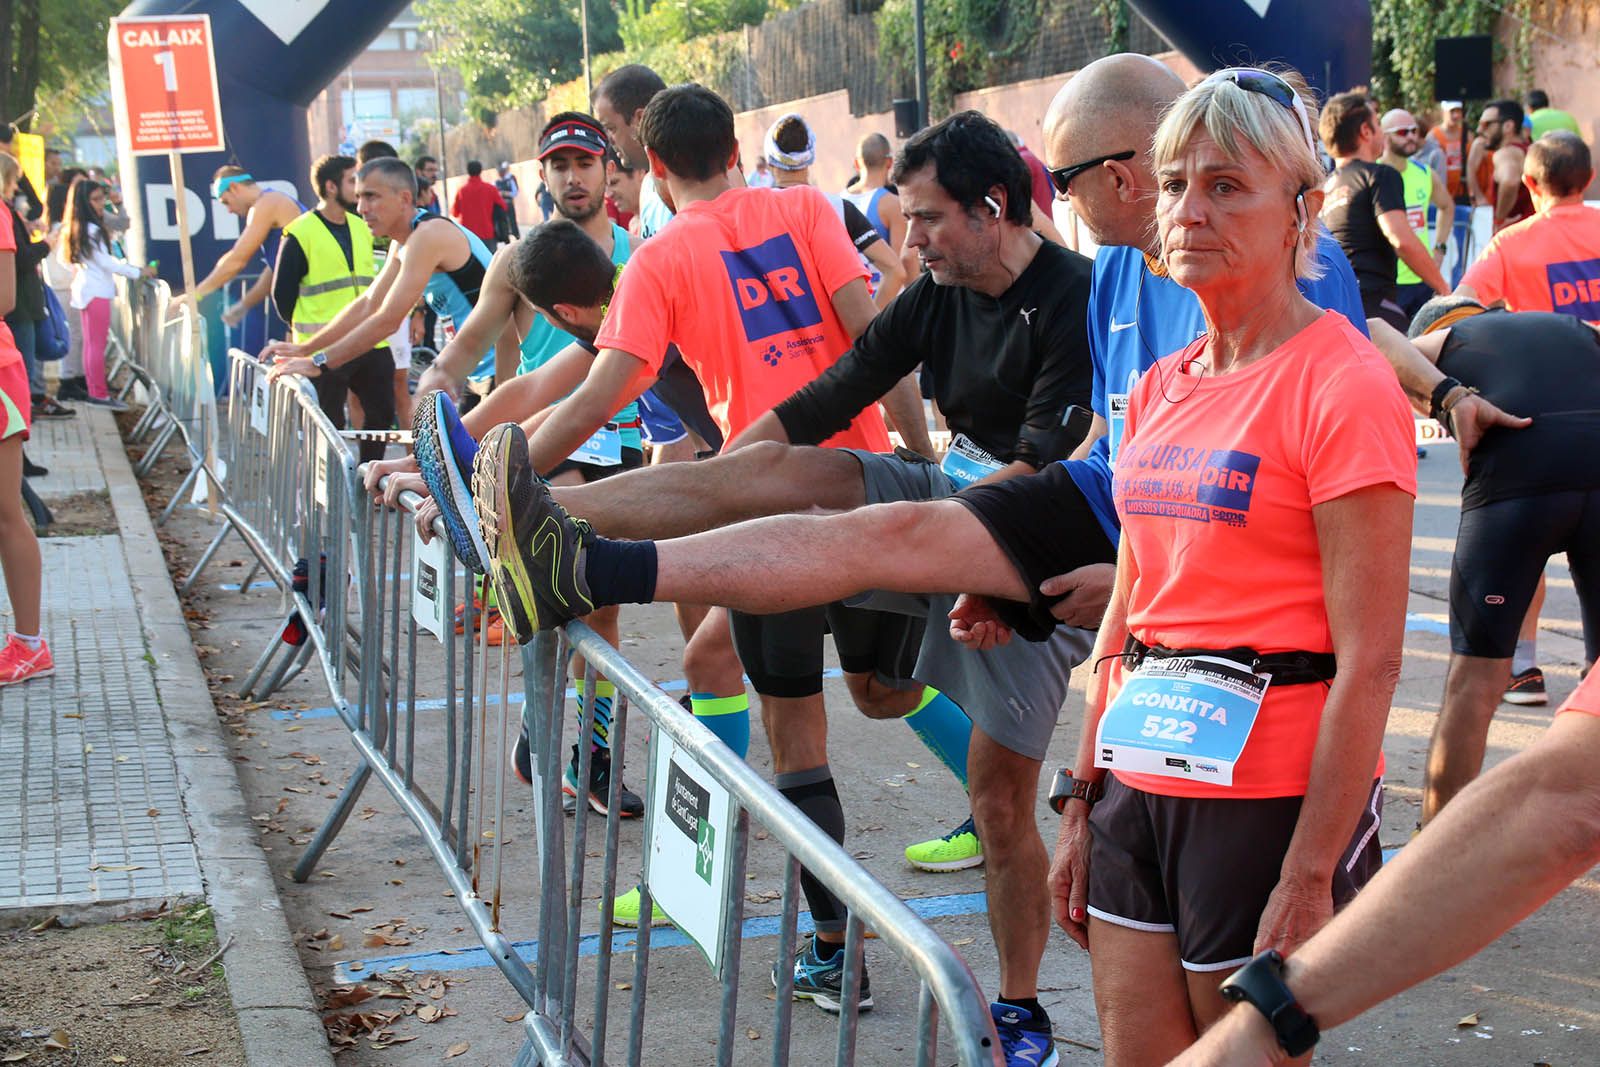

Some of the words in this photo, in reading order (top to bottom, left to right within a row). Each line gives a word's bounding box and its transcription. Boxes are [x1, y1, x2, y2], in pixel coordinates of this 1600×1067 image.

[123, 28, 204, 47] CALAIX
[153, 51, 178, 91] 1
[1138, 445, 1206, 471] CURSA
[1200, 466, 1251, 492] DiR
[1127, 501, 1158, 514] MOSSOS
[1160, 504, 1209, 521] D'ESQUADRA
[1166, 659, 1194, 673] DiR
[1131, 692, 1228, 727] CONXITA
[1140, 714, 1198, 744] 522
